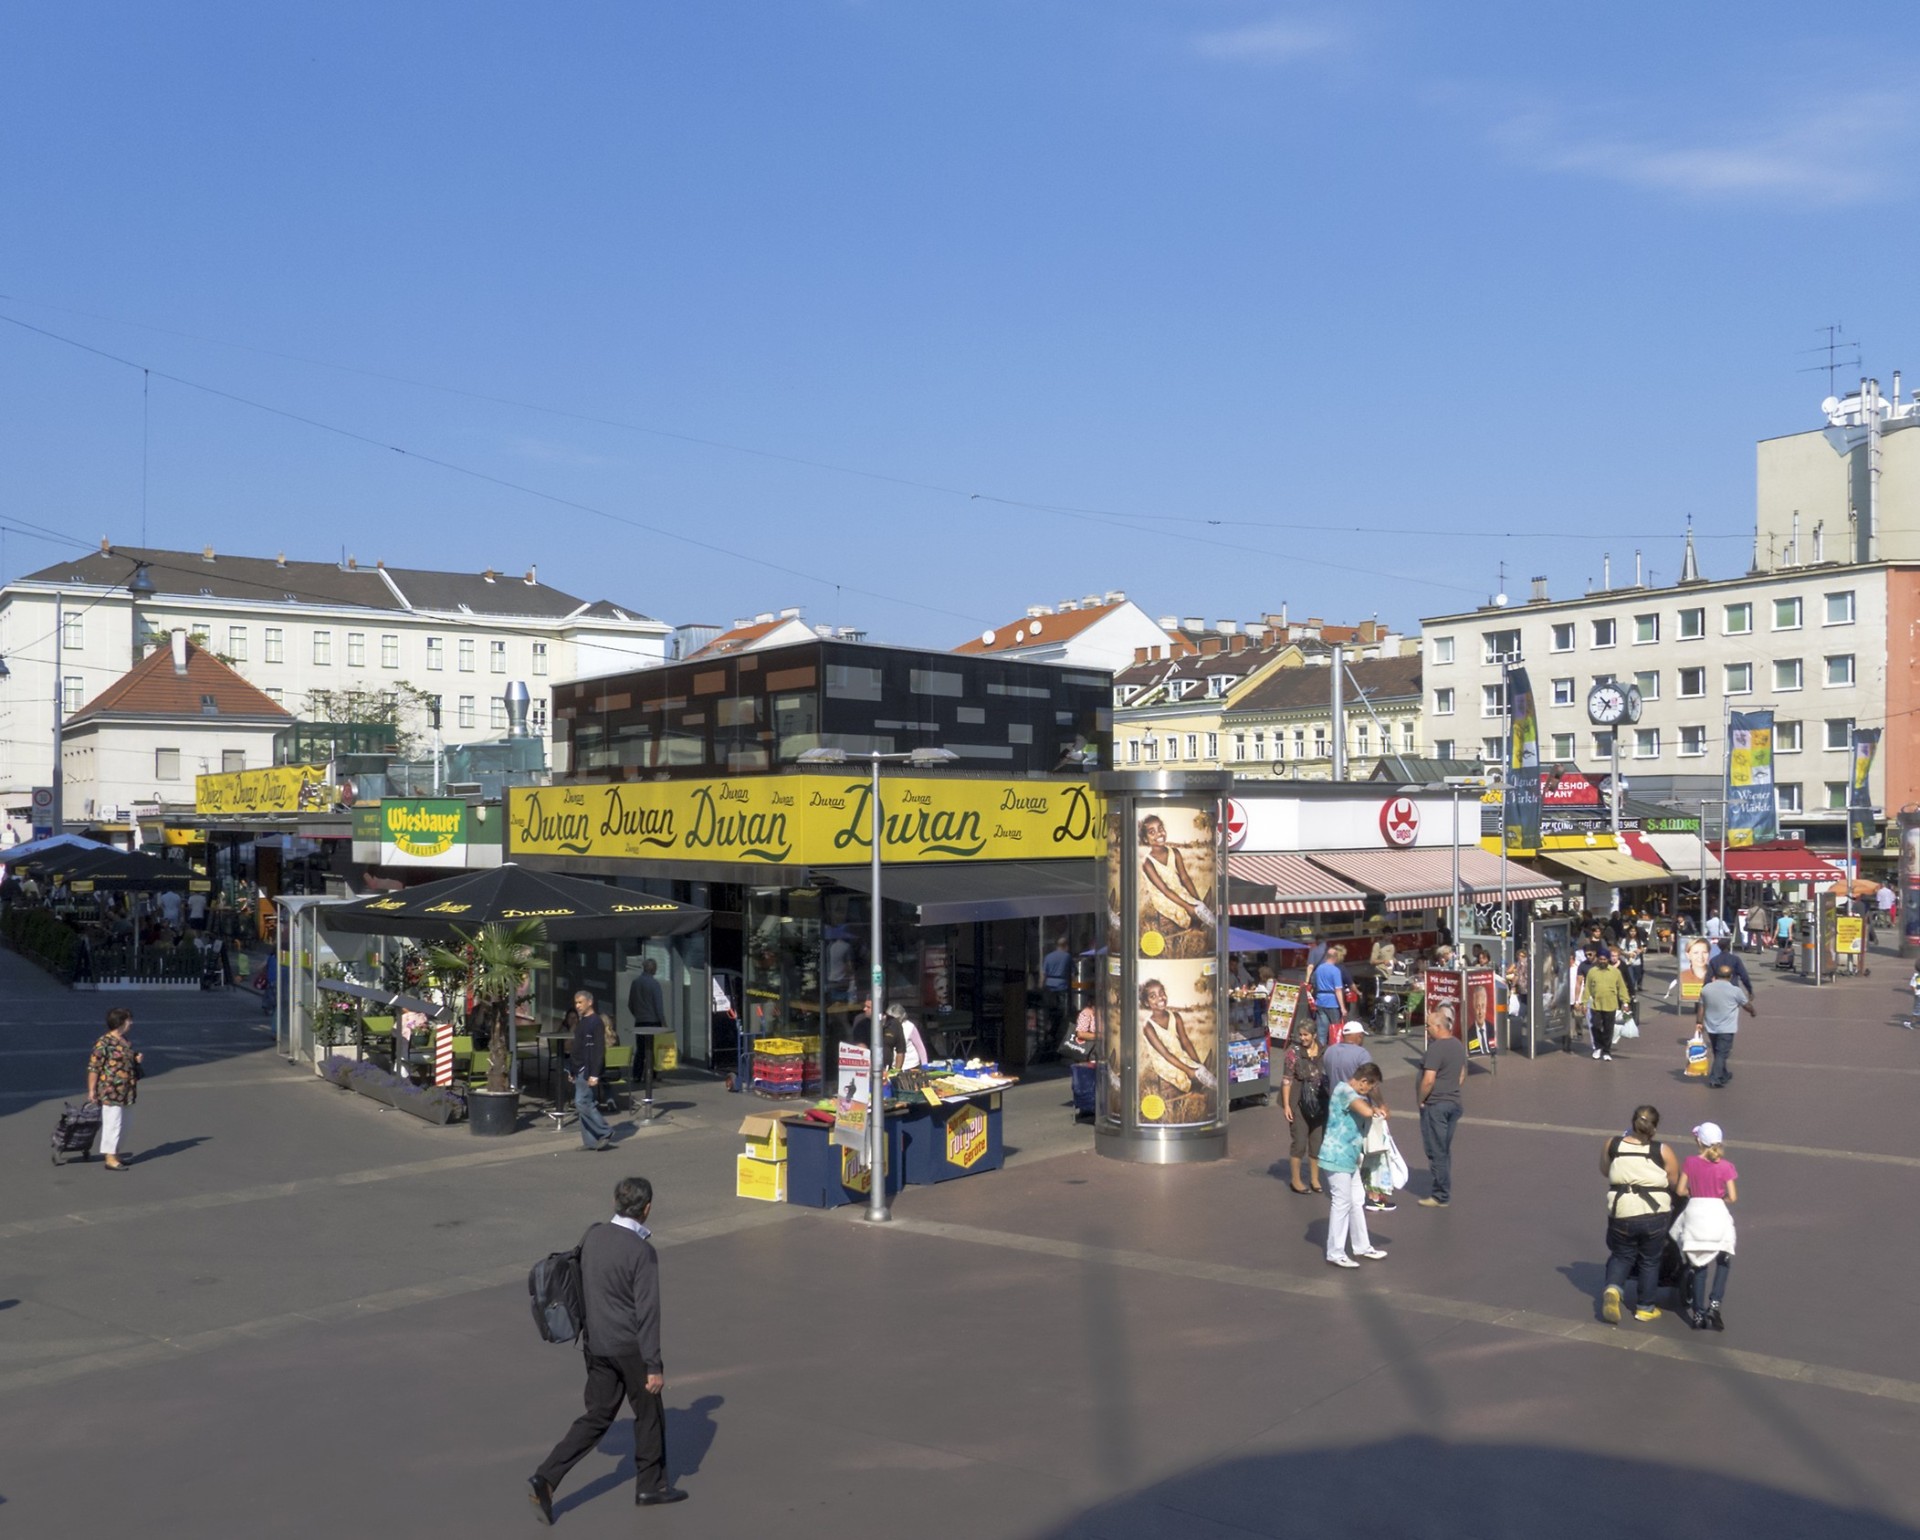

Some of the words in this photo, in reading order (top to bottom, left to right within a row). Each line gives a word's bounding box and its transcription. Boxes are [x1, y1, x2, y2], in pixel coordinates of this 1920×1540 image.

[720, 782, 750, 803] Duran
[1541, 782, 1590, 790] FESHOP
[1737, 789, 1771, 800] Wiener
[564, 788, 585, 806] Duran
[772, 790, 795, 807] Duran
[809, 791, 846, 810] Duran
[902, 789, 932, 805] Duran
[1000, 787, 1049, 815] Duran
[387, 806, 462, 833] Wiesbauer
[521, 791, 593, 855] Duran
[600, 785, 678, 848] Duran
[684, 785, 793, 862] Duran
[834, 783, 987, 857] Duran
[993, 824, 1023, 841] Duran
[501, 908, 575, 918] Duran
[611, 903, 679, 912] Duran
